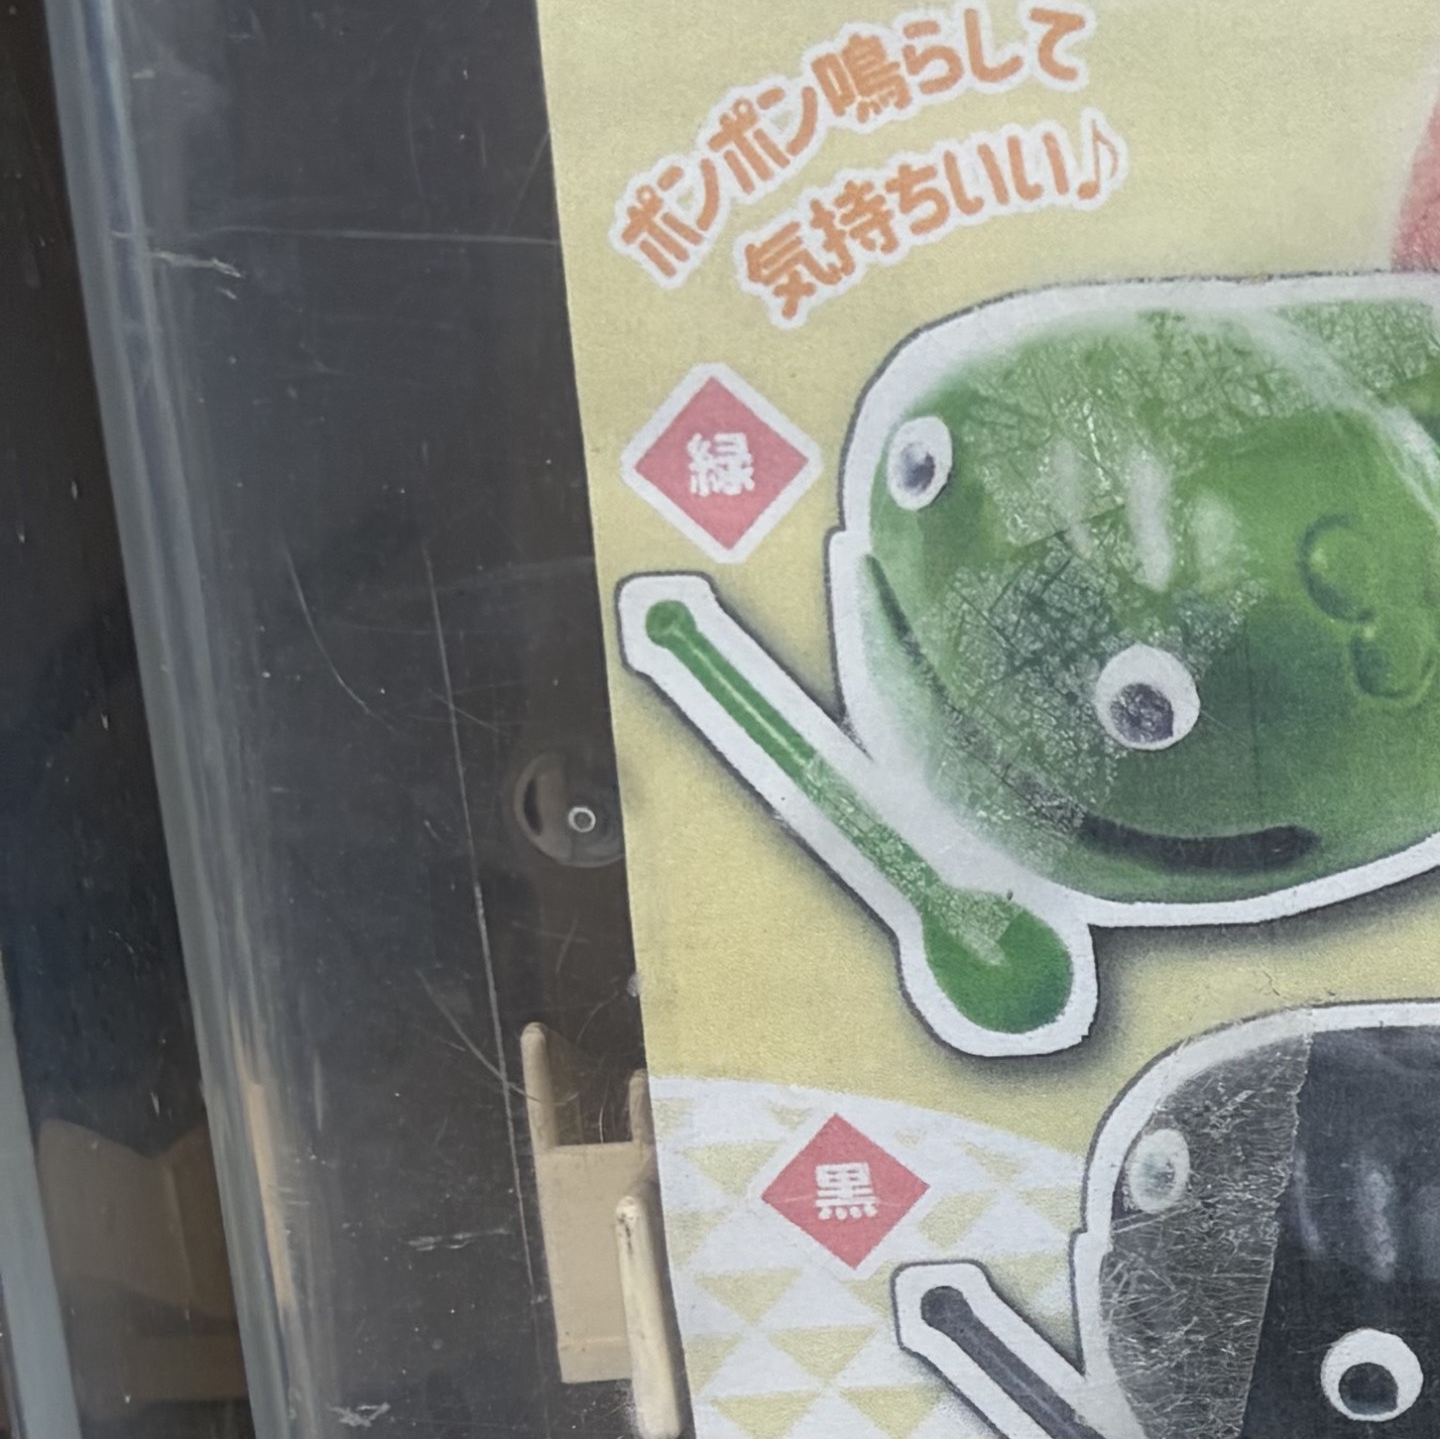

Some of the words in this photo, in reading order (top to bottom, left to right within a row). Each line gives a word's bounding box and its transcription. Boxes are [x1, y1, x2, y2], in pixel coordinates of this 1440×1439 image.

[621, 7, 1086, 278] ポンポン鳴らして
[687, 431, 755, 496] 緑
[814, 1161, 879, 1221] 黒
